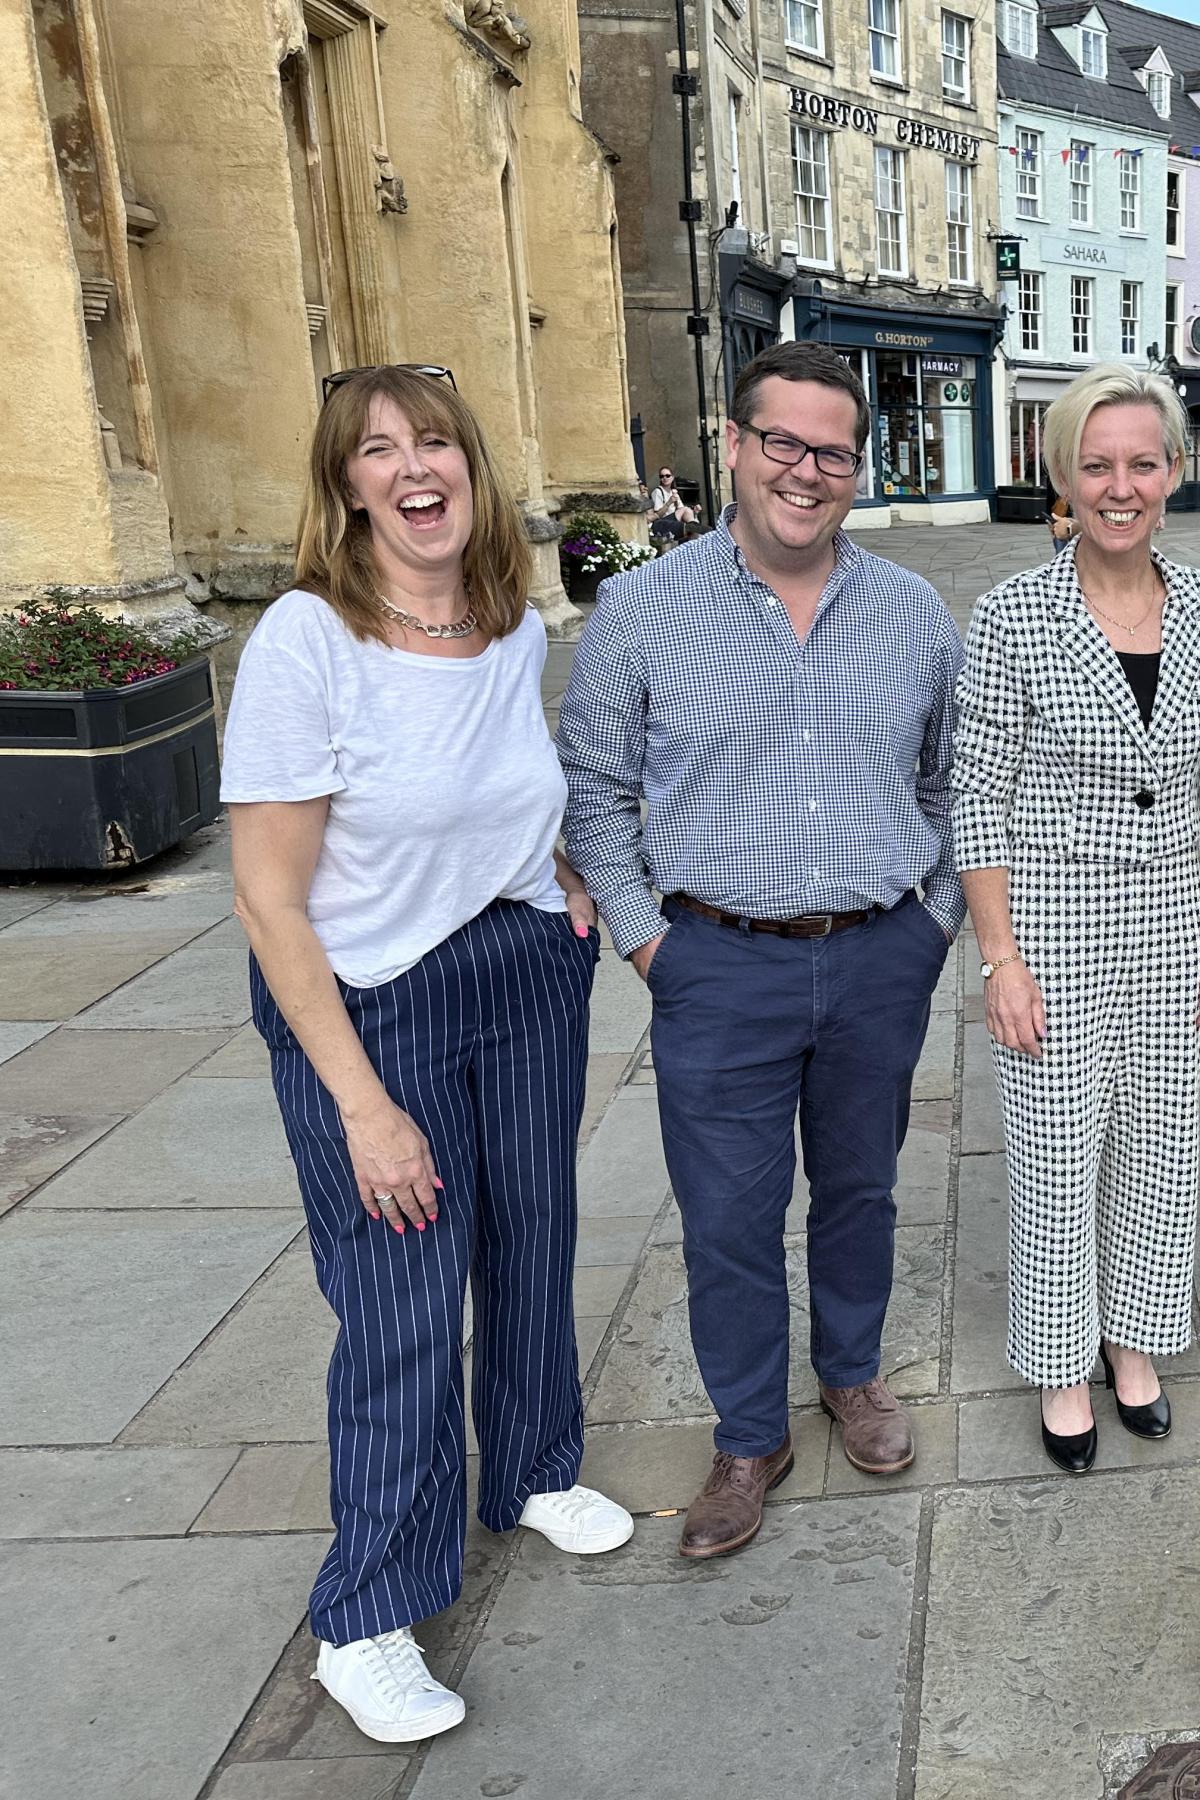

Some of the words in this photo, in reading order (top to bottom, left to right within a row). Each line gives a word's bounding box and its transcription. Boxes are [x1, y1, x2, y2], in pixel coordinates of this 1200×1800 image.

[788, 88, 878, 135] HORTON
[896, 119, 980, 160] CHEMIST
[1063, 244, 1107, 264] SAHARA
[922, 360, 960, 373] HARMACY
